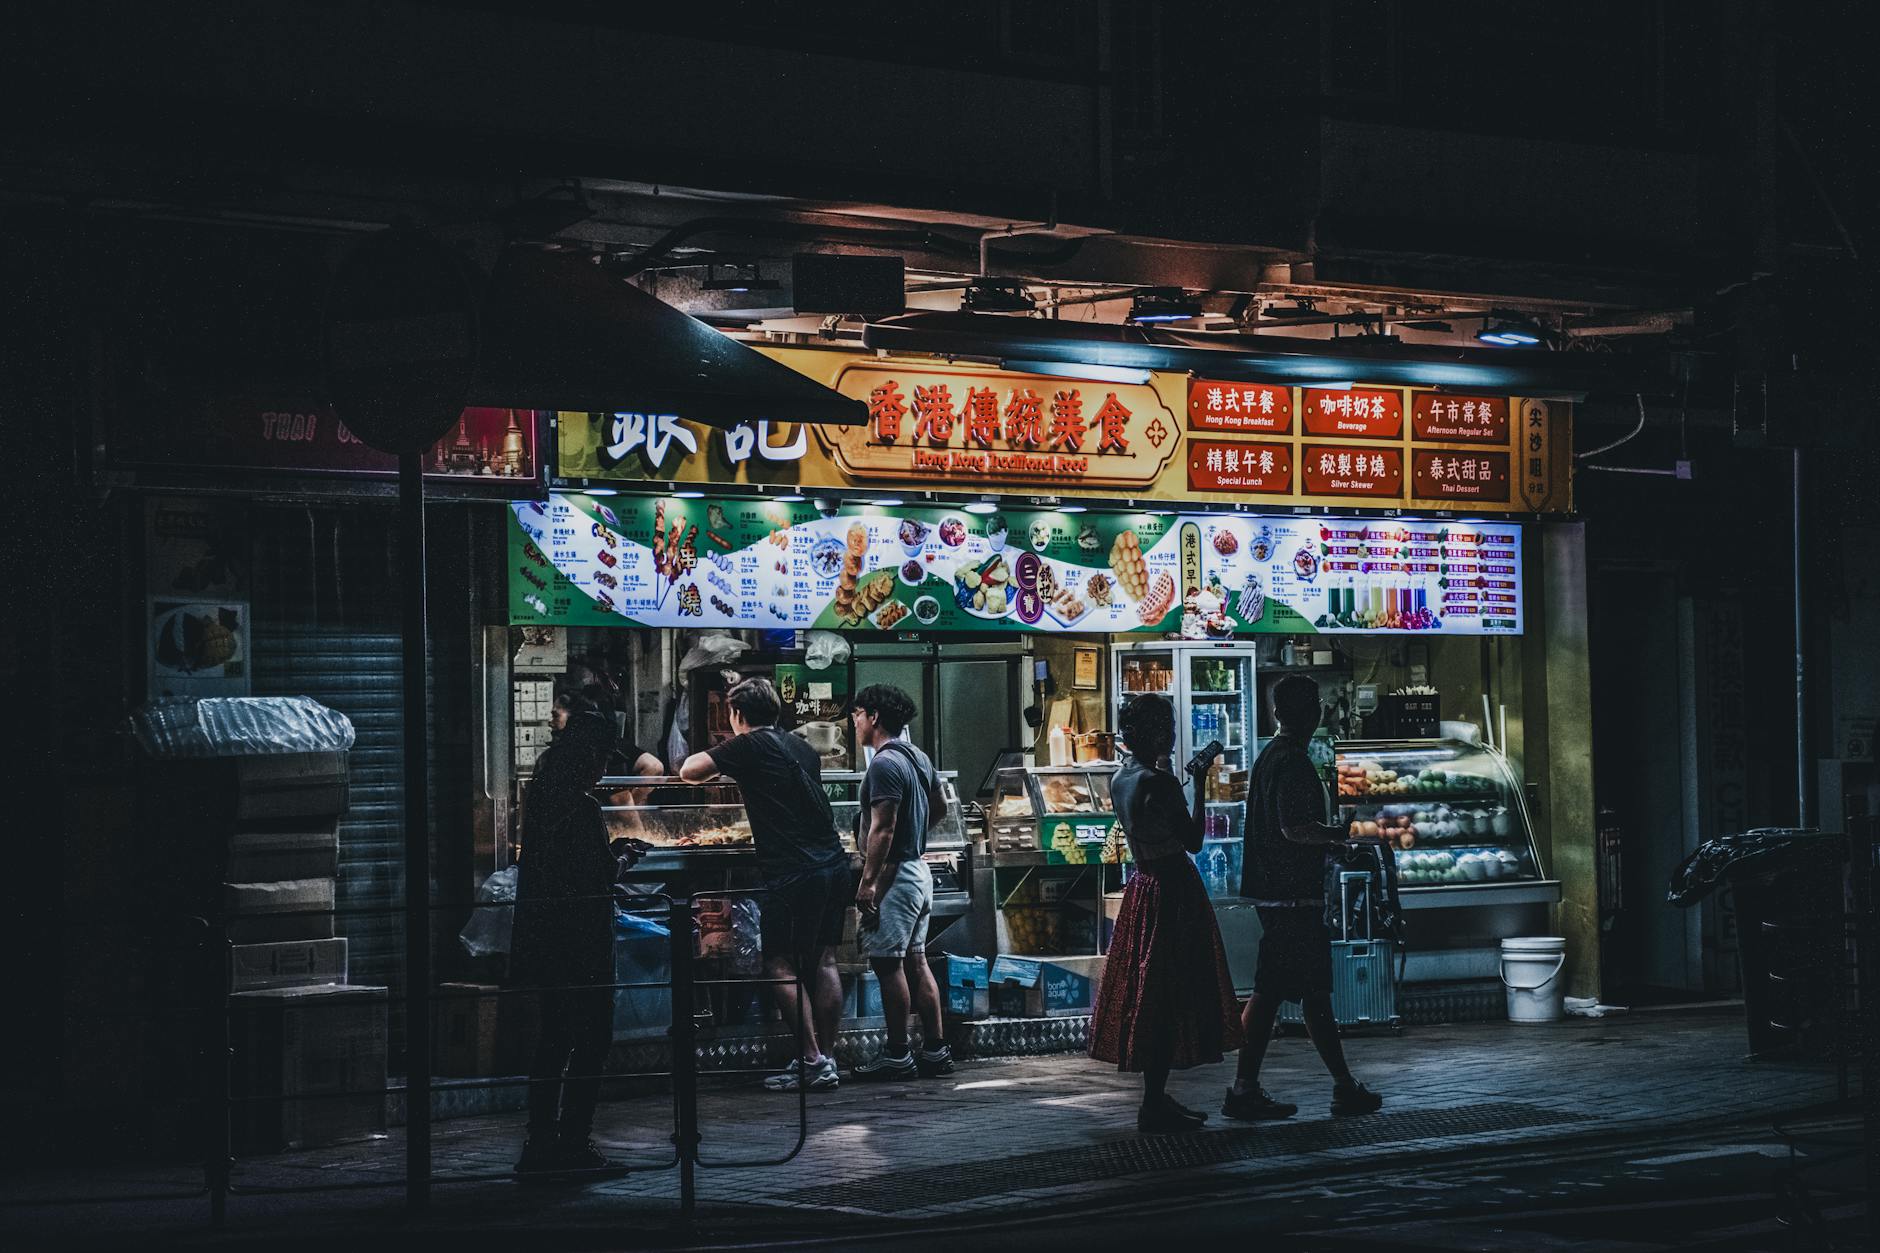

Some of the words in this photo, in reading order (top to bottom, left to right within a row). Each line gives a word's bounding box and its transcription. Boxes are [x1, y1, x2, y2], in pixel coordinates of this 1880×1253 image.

[1207, 387, 1275, 414] 港式早餐
[1320, 394, 1386, 420] 咖啡奶茶
[1430, 399, 1493, 424] 午市常餐
[869, 379, 1133, 452] 香港傳統美食
[1206, 415, 1223, 426] Hong
[1224, 416, 1242, 426] Kong
[1243, 416, 1274, 427] Breakfast
[1337, 421, 1367, 432] Beverage
[1427, 425, 1457, 435] Afternoon
[1458, 427, 1482, 437] Regular
[1483, 428, 1493, 436] Set
[914, 450, 950, 470] Hong
[951, 452, 986, 471] Kong
[986, 452, 1054, 471] Traditional
[1056, 455, 1088, 472] Food
[1206, 448, 1274, 474] 精製午餐
[1319, 453, 1386, 478] 秘製串燒
[1430, 457, 1491, 481] 泰式甜品
[1217, 476, 1241, 486] Special
[1242, 477, 1263, 486] Lunch
[1331, 480, 1350, 488] Silver
[1351, 480, 1374, 489] Skewer
[1442, 484, 1455, 492] Thai
[1456, 484, 1480, 493] Dessert
[795, 699, 821, 716] 咖啡
